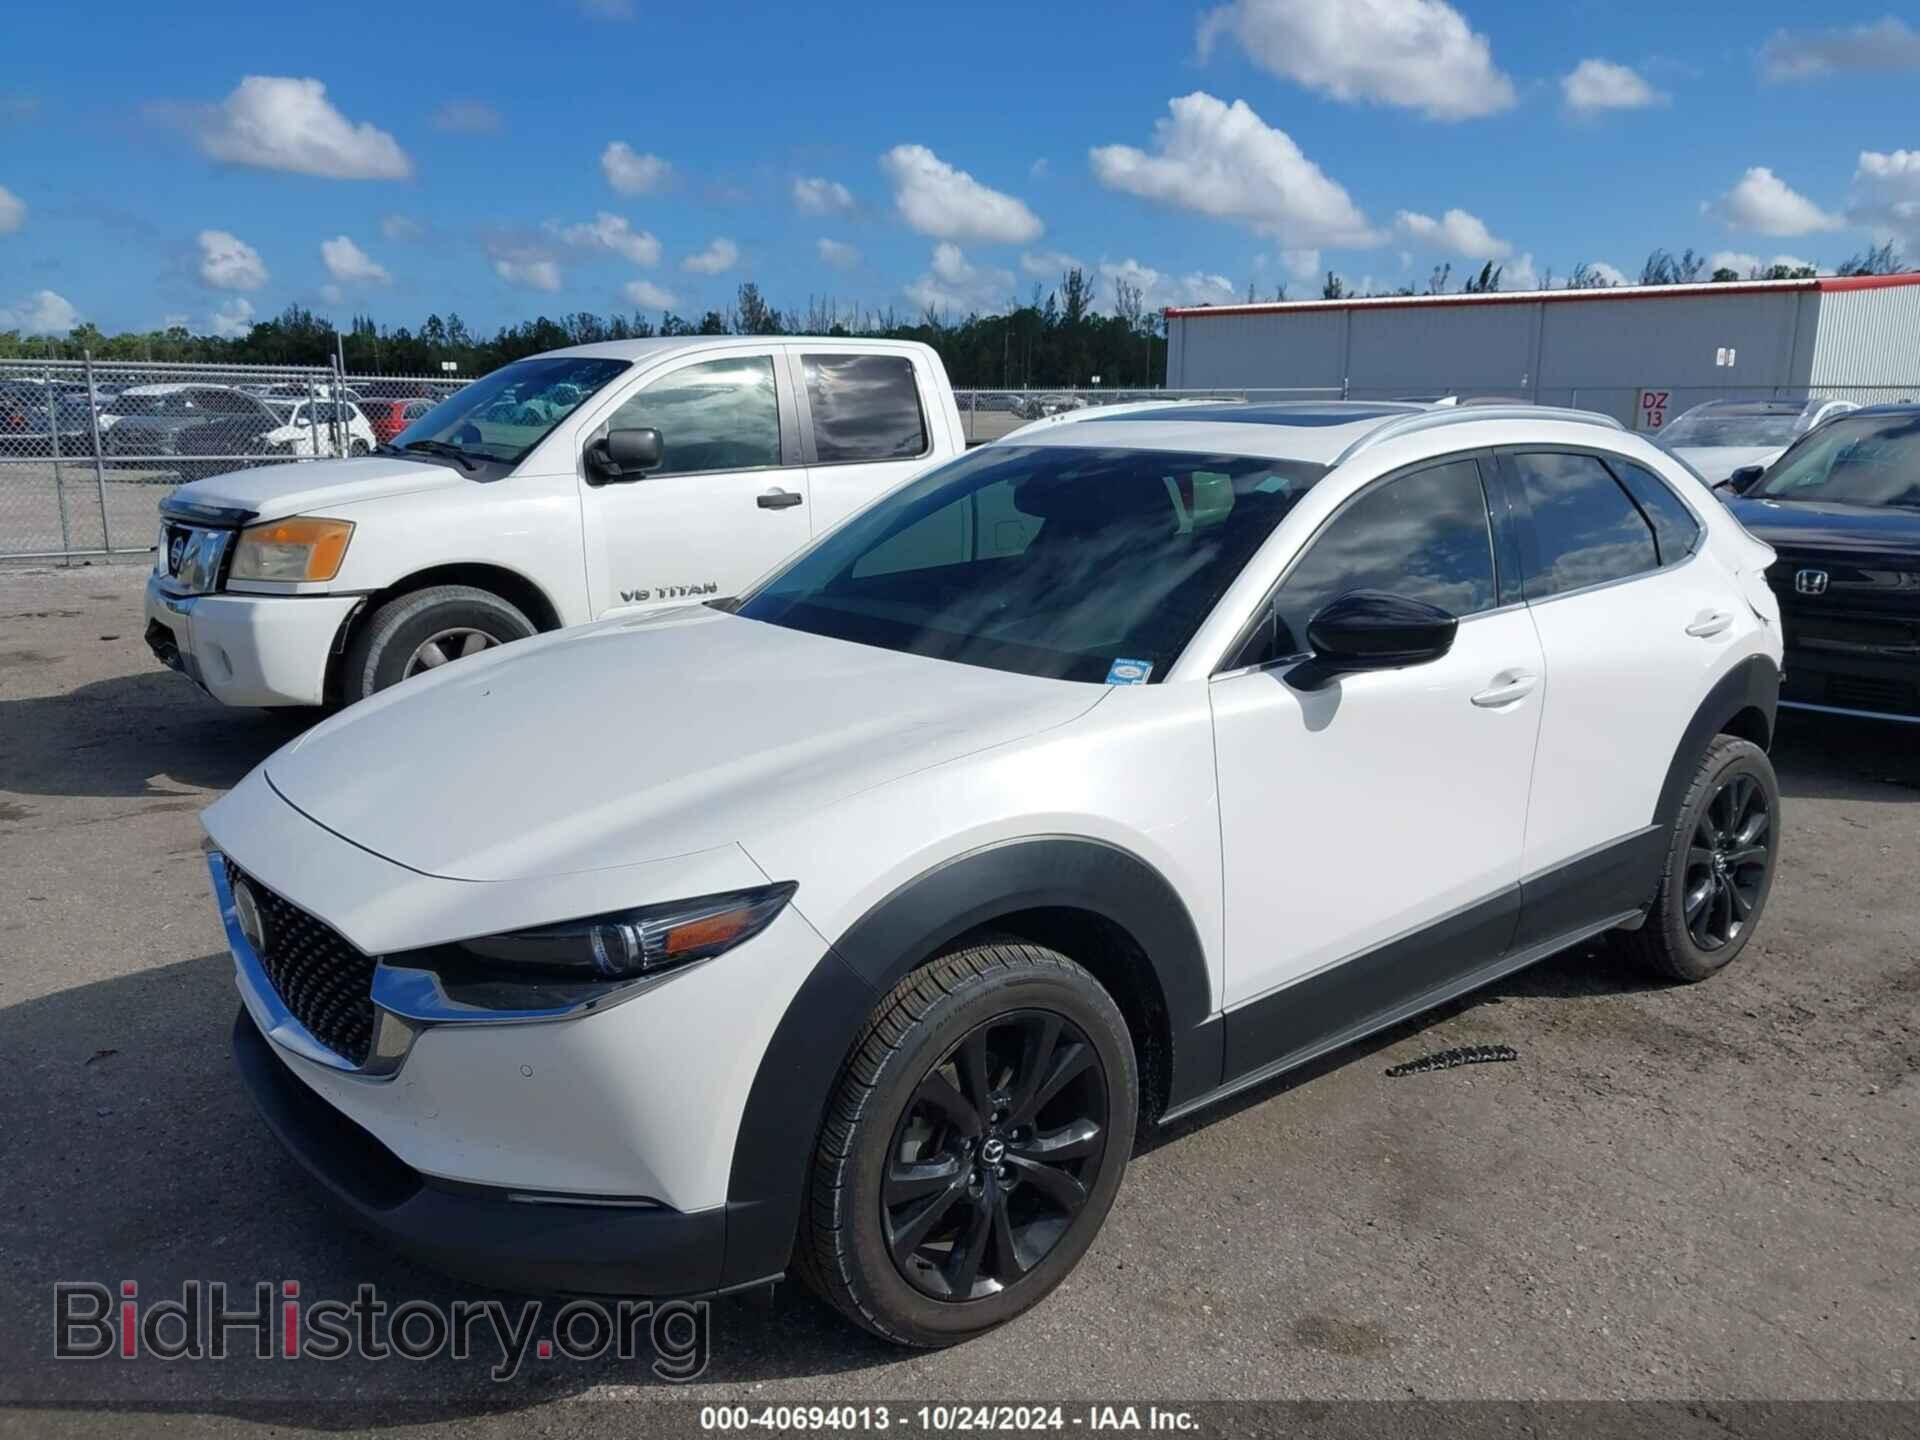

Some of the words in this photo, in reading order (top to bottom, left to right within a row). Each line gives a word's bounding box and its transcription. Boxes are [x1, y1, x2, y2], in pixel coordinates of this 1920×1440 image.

[1643, 392, 1668, 409] DZ
[1647, 411, 1663, 428] 13
[655, 581, 718, 599] TITAN
